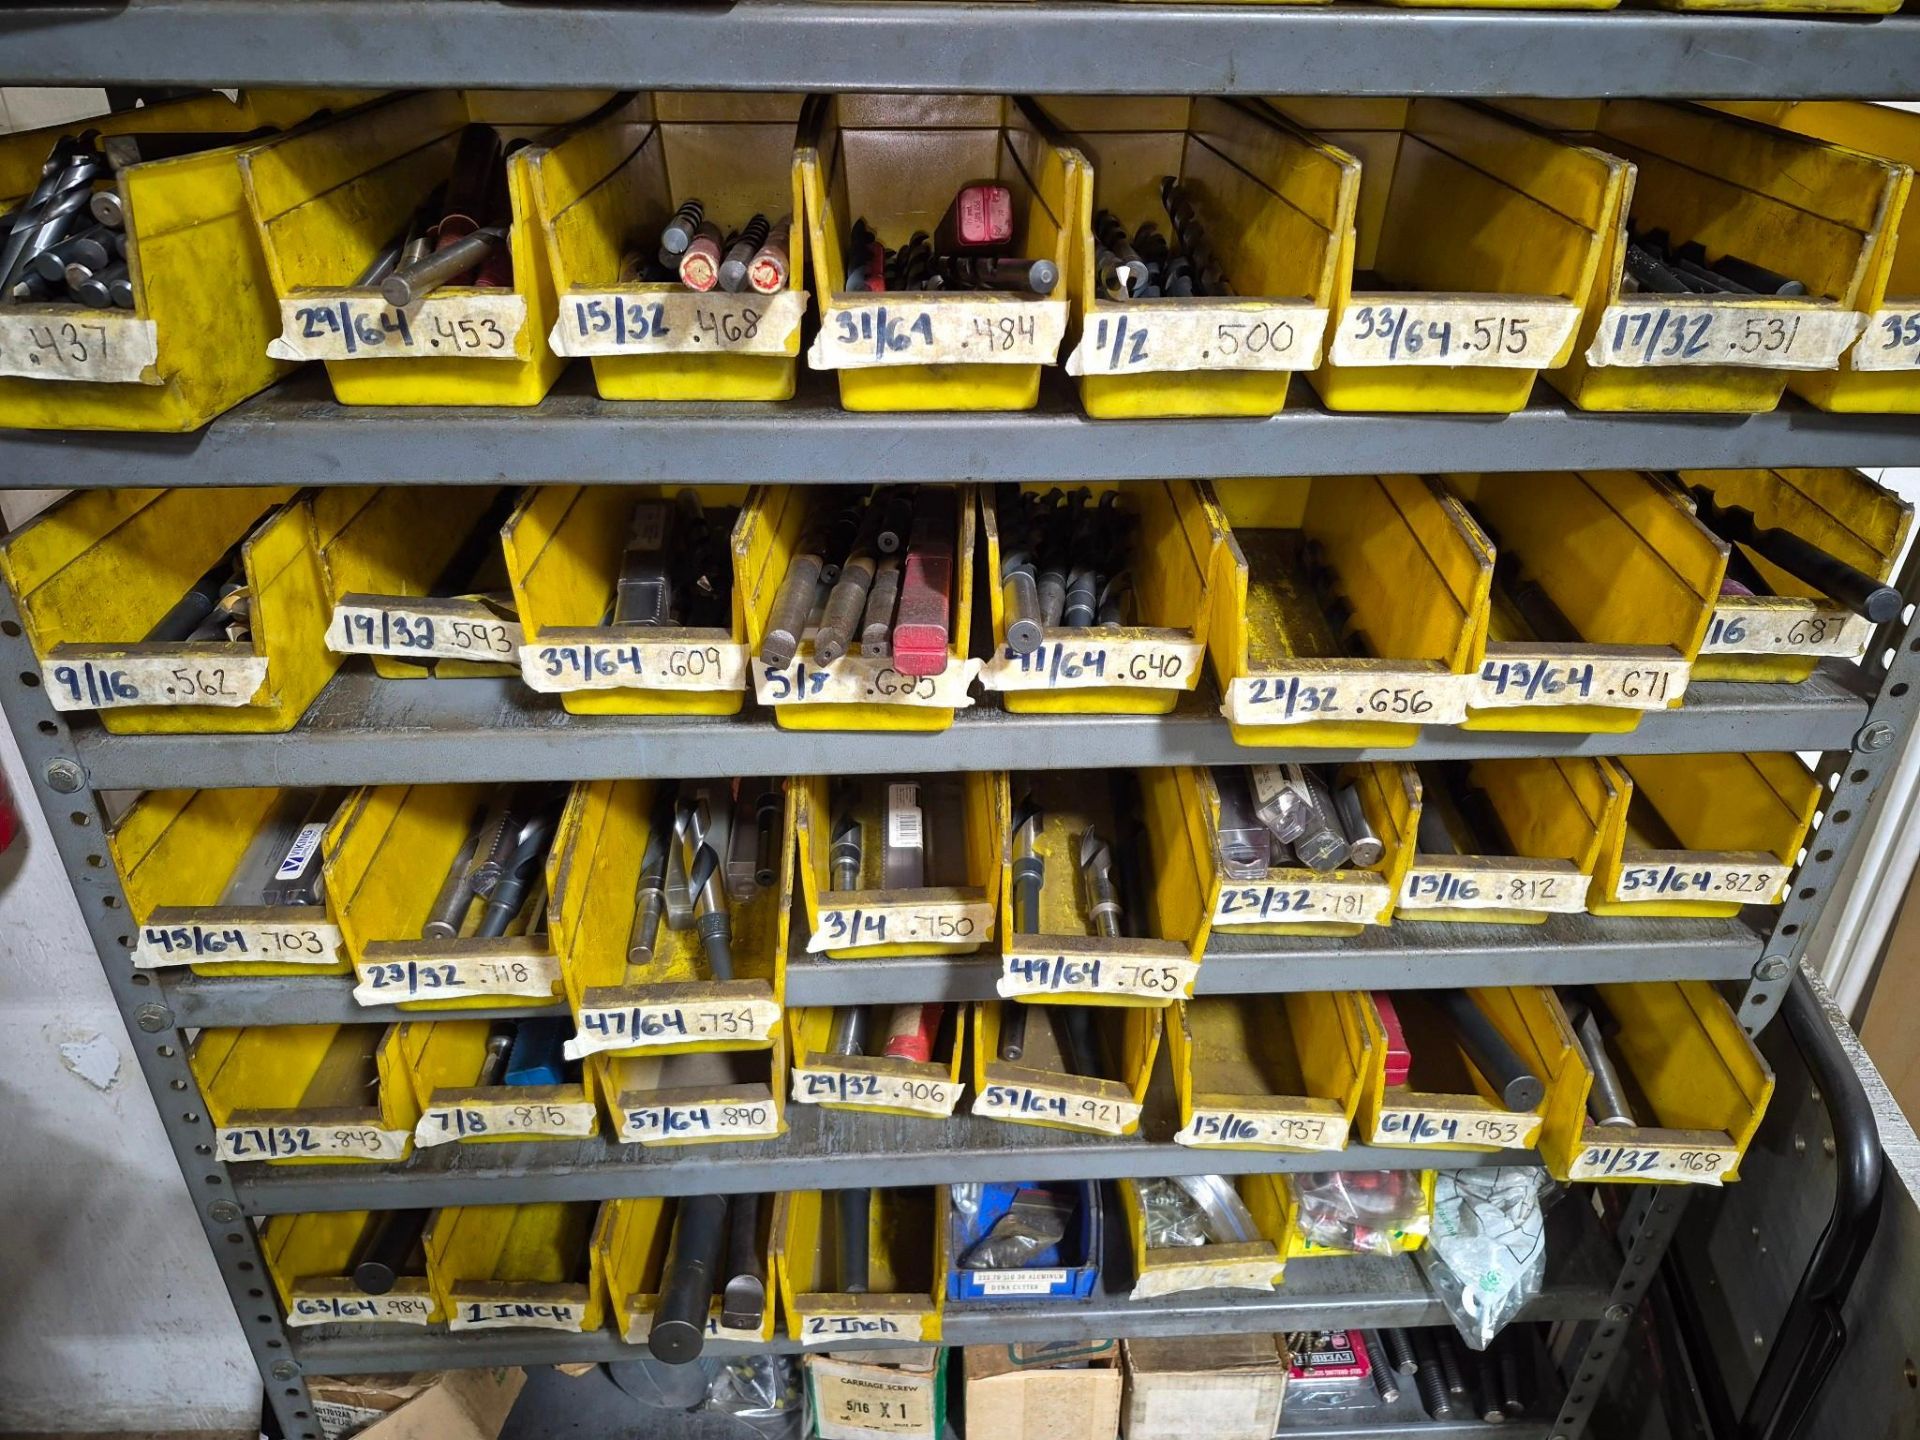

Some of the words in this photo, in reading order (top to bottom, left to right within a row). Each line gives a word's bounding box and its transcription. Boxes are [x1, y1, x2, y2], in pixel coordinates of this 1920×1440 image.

[295, 301, 412, 352] 29/64
[430, 314, 505, 351] .453
[578, 295, 668, 344] 15/32
[693, 308, 763, 345] .468
[960, 314, 1036, 351] .484
[1355, 307, 1450, 359] 33/64
[1463, 318, 1530, 354] .515
[1613, 309, 1713, 361] 17/32
[1728, 316, 1799, 353] .531
[29, 323, 107, 364] .437
[1097, 317, 1149, 368] 1/2
[1202, 321, 1293, 359] .500
[1881, 312, 1920, 363] 35
[343, 613, 435, 649] 19/32
[450, 622, 513, 653] .593
[1774, 617, 1845, 645] .687
[540, 646, 641, 681] 39/64
[662, 647, 723, 680] .609
[1117, 654, 1182, 681] .640
[54, 665, 137, 705] 9/16
[167, 668, 238, 697] .562
[1481, 660, 1594, 700] 43/64
[1606, 672, 1667, 700] .671
[1248, 676, 1339, 717] 21/32
[1356, 689, 1433, 715] .656
[289, 830, 313, 859] VIKING
[1408, 873, 1479, 902] 13/16
[1496, 878, 1557, 901] .812
[1622, 865, 1711, 894] 53/64
[1713, 872, 1771, 894] .828
[1220, 887, 1311, 919] 25/32
[1323, 894, 1363, 916] .781
[145, 927, 248, 954] 45/64
[262, 931, 325, 955] .703
[825, 910, 886, 942] 3/4
[910, 916, 974, 937] .750
[367, 962, 466, 993] 23/32
[1009, 957, 1101, 990] 49/64
[1118, 964, 1178, 992] .765
[584, 1010, 686, 1040] 47/64
[699, 1008, 753, 1033] .734
[803, 1073, 880, 1102] 29/32
[893, 1080, 945, 1103] .906
[429, 1111, 487, 1134] 7/8
[509, 1105, 565, 1127] .875
[720, 1106, 767, 1128] .890
[986, 1086, 1067, 1115] 59/64
[1075, 1099, 1121, 1125] .921
[225, 1129, 320, 1156] 27/32
[331, 1130, 382, 1152] .843
[1193, 1115, 1258, 1141] 15/16
[1271, 1118, 1326, 1141] .937
[1380, 1112, 1456, 1142] 61/64
[1467, 1119, 1519, 1141] .953
[1583, 1147, 1659, 1174] 31/32
[1670, 1150, 1722, 1172] .968
[296, 1297, 375, 1320] 63/64
[386, 1299, 427, 1317] .984
[468, 1301, 486, 1322] 1
[494, 1303, 571, 1322] INCH
[808, 1316, 827, 1333] 2
[832, 1315, 899, 1334] Inch
[840, 1377, 884, 1391] CARRIAGE
[887, 1384, 918, 1392] SCREW
[846, 1400, 870, 1414] 5/16
[880, 1402, 891, 1419] X
[899, 1403, 907, 1419] 1
